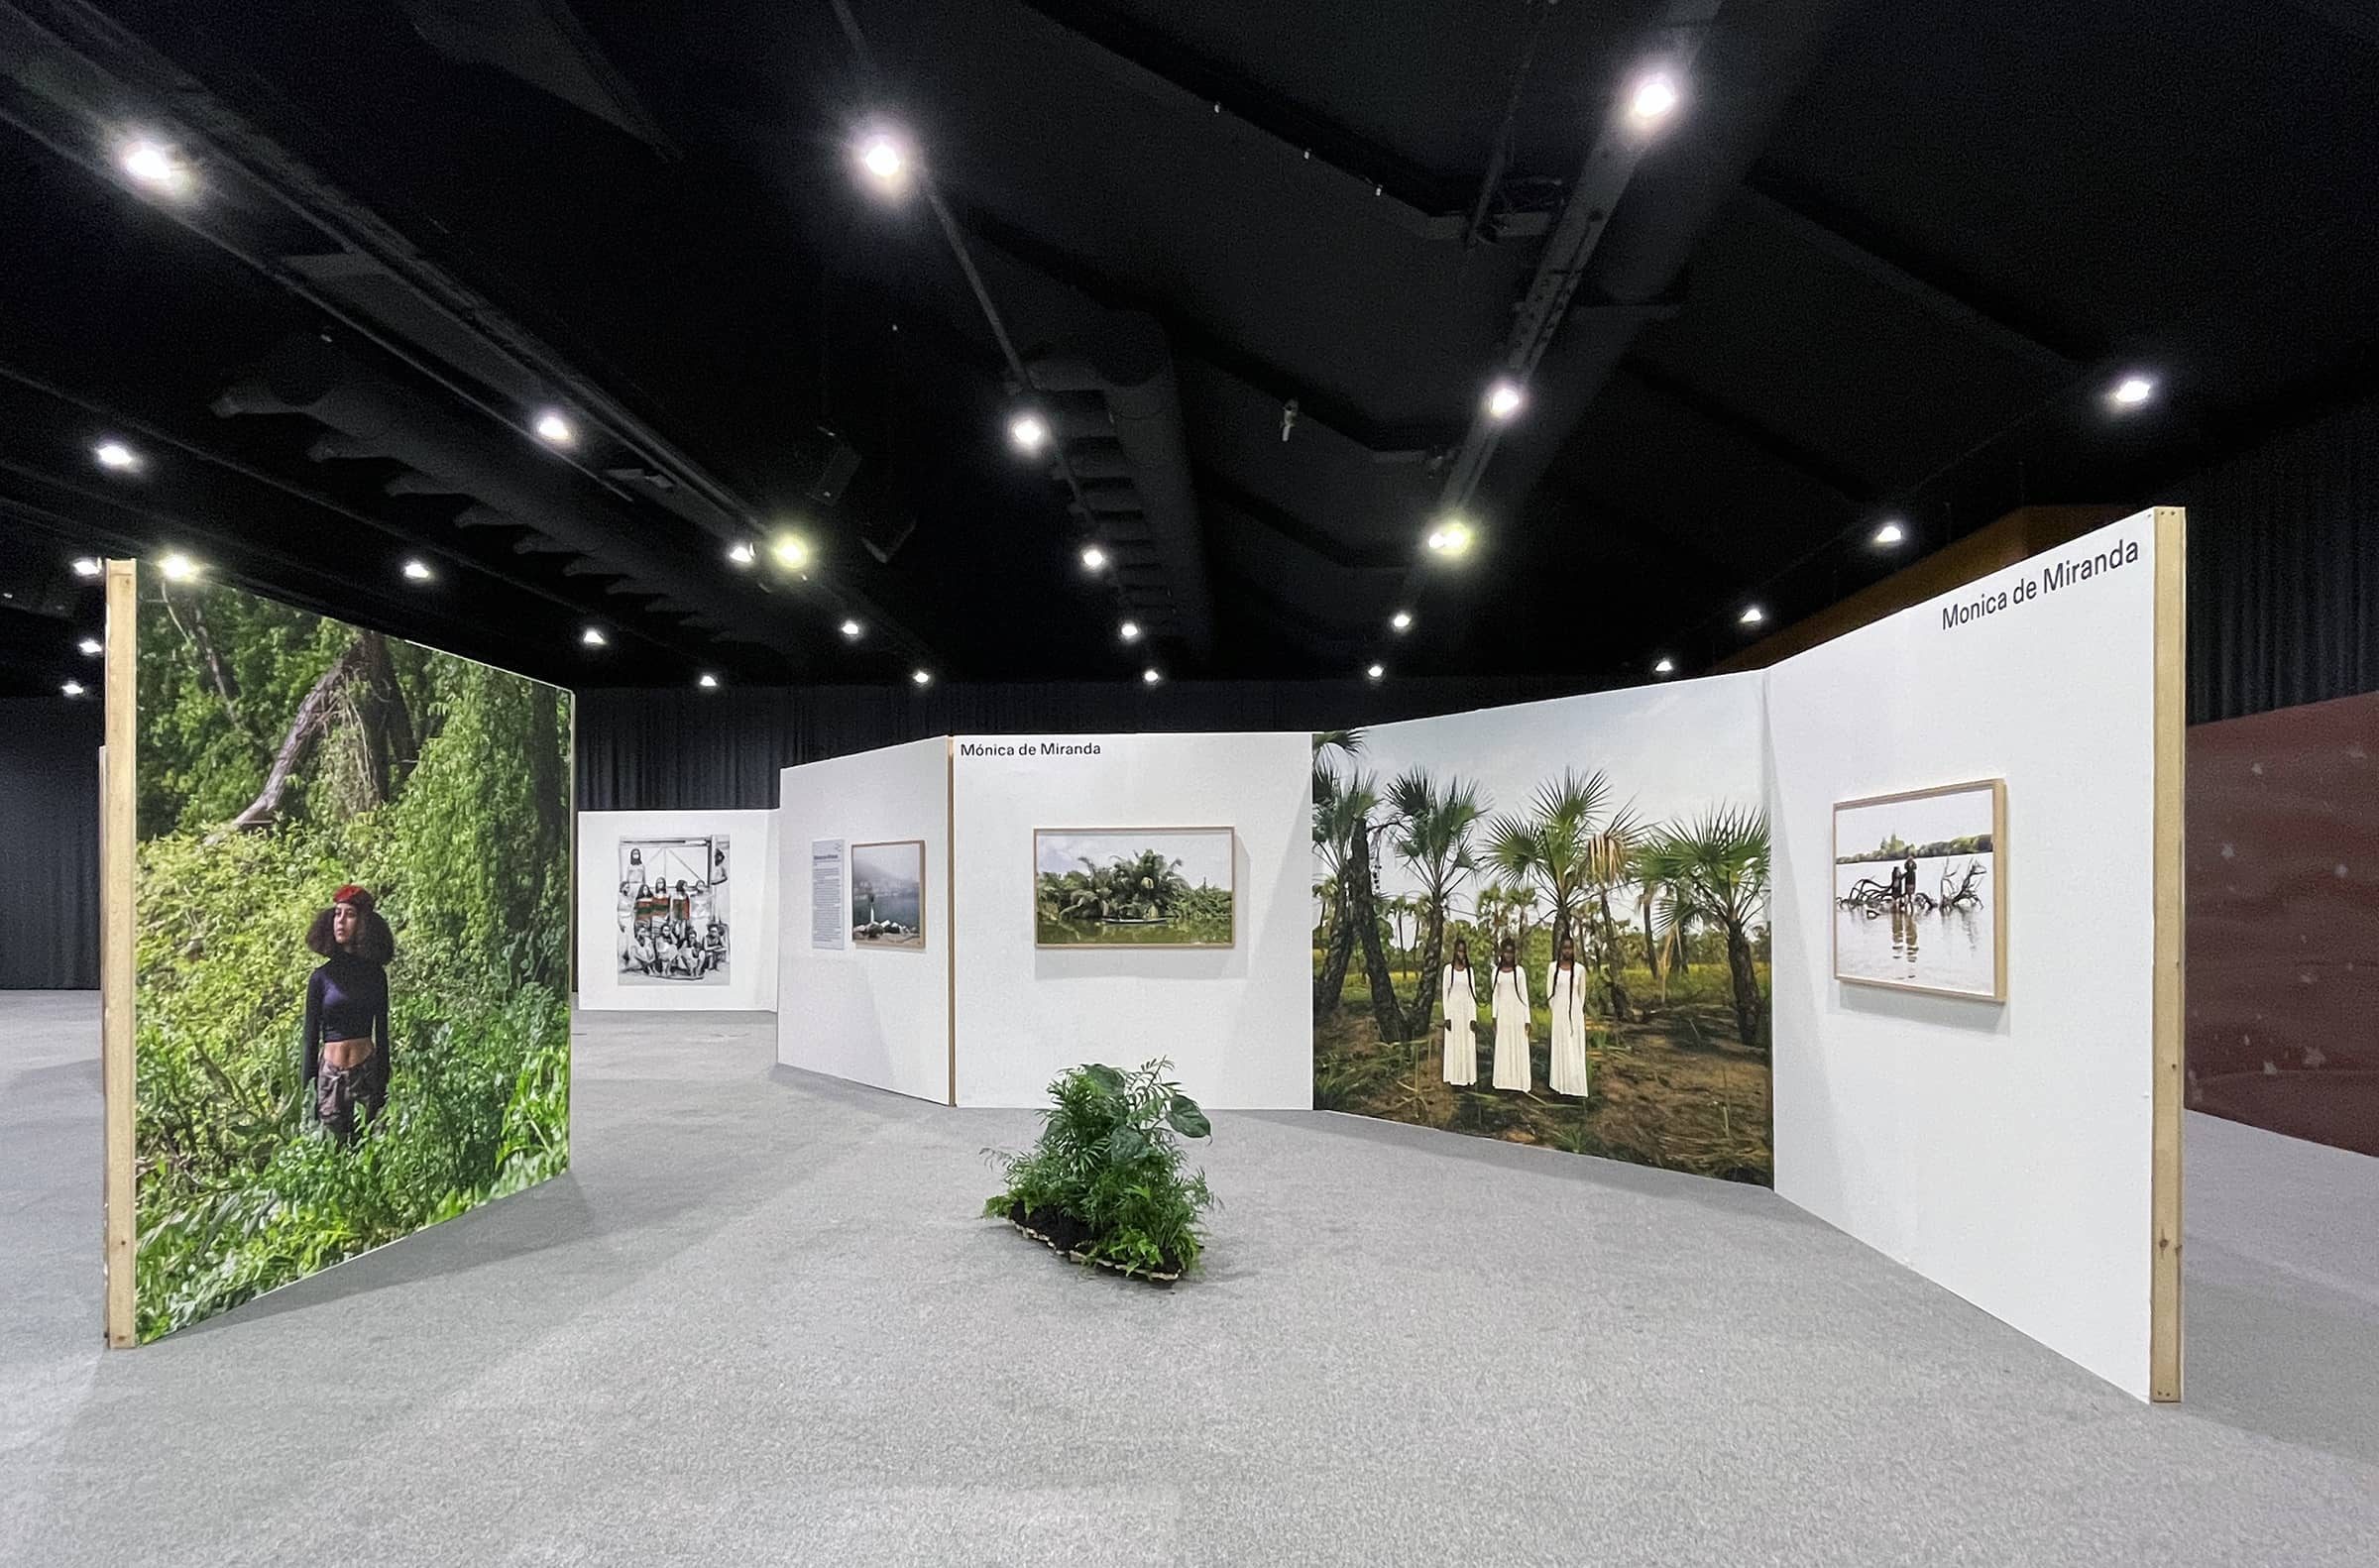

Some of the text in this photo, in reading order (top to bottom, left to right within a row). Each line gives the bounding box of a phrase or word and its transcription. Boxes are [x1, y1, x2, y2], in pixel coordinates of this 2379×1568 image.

[1942, 539, 2139, 630] Monica de Miranda
[961, 742, 1101, 756] Mónica de Miranda
